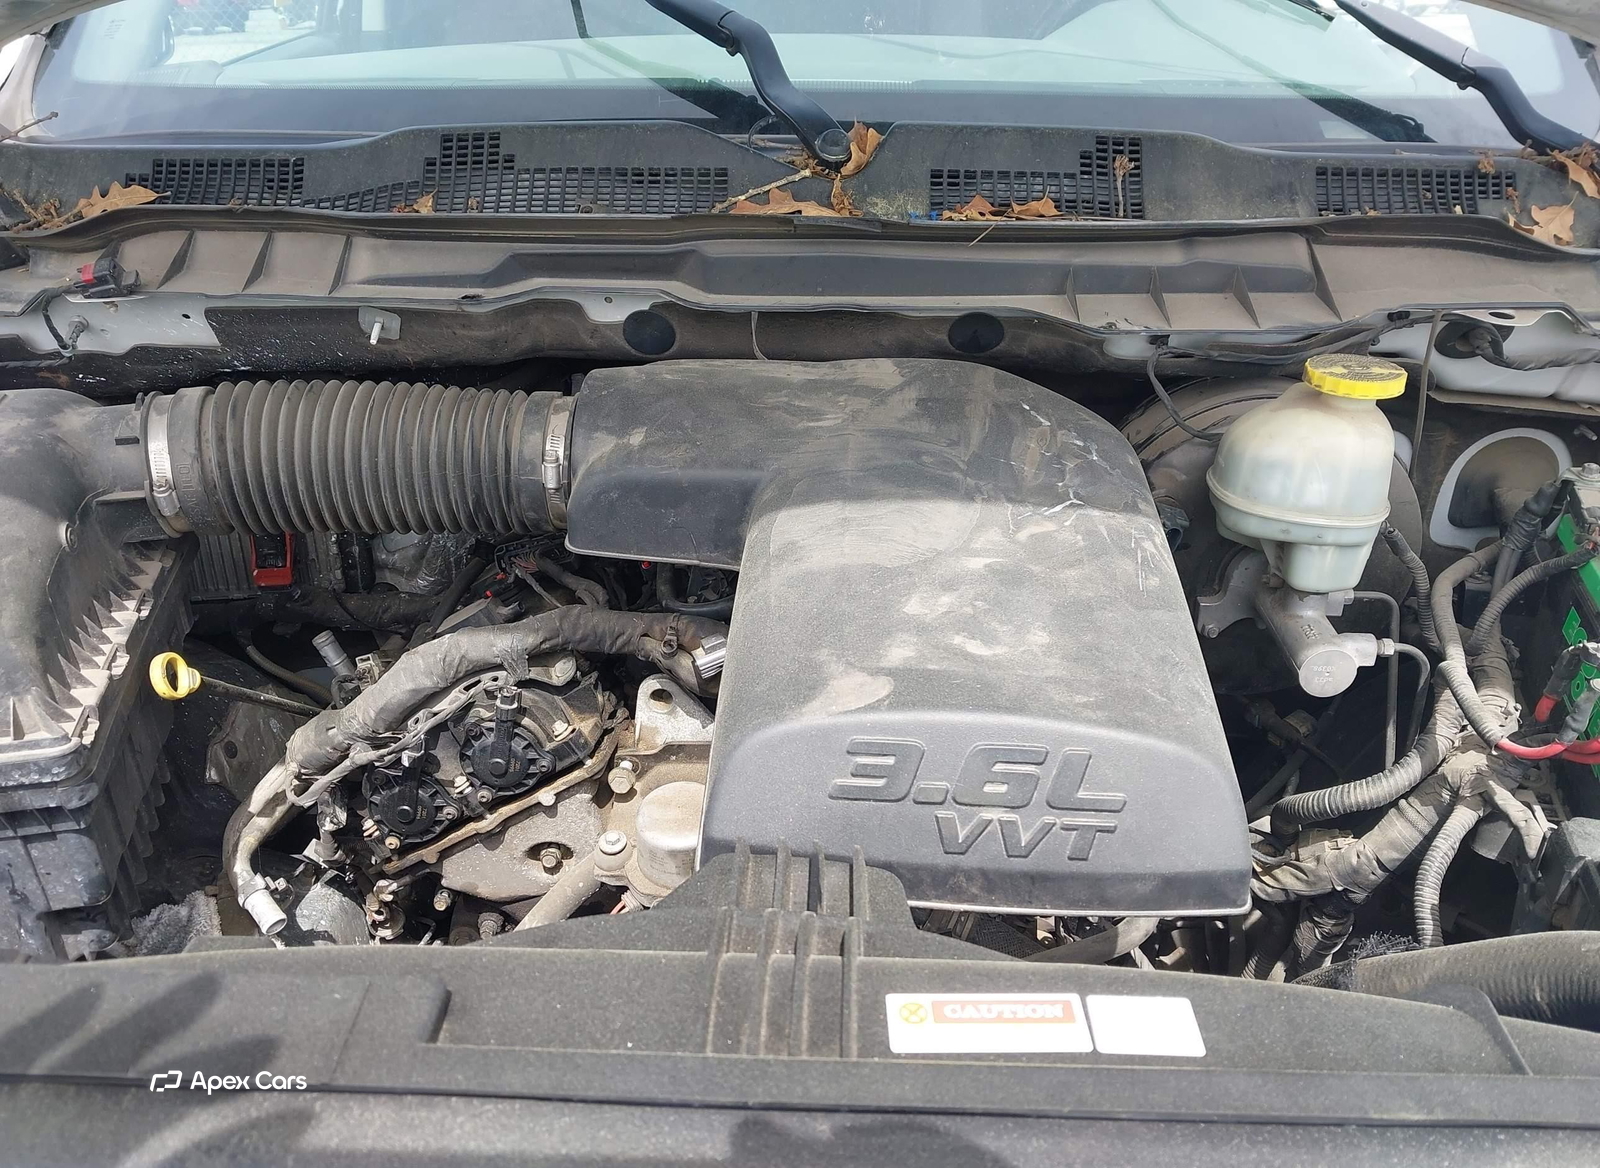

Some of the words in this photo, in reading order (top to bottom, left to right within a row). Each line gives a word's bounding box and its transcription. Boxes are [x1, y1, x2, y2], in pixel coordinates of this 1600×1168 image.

[828, 736, 1127, 813] 3.6L
[934, 811, 1118, 861] VVT
[943, 1003, 1065, 1019] CAUTION
